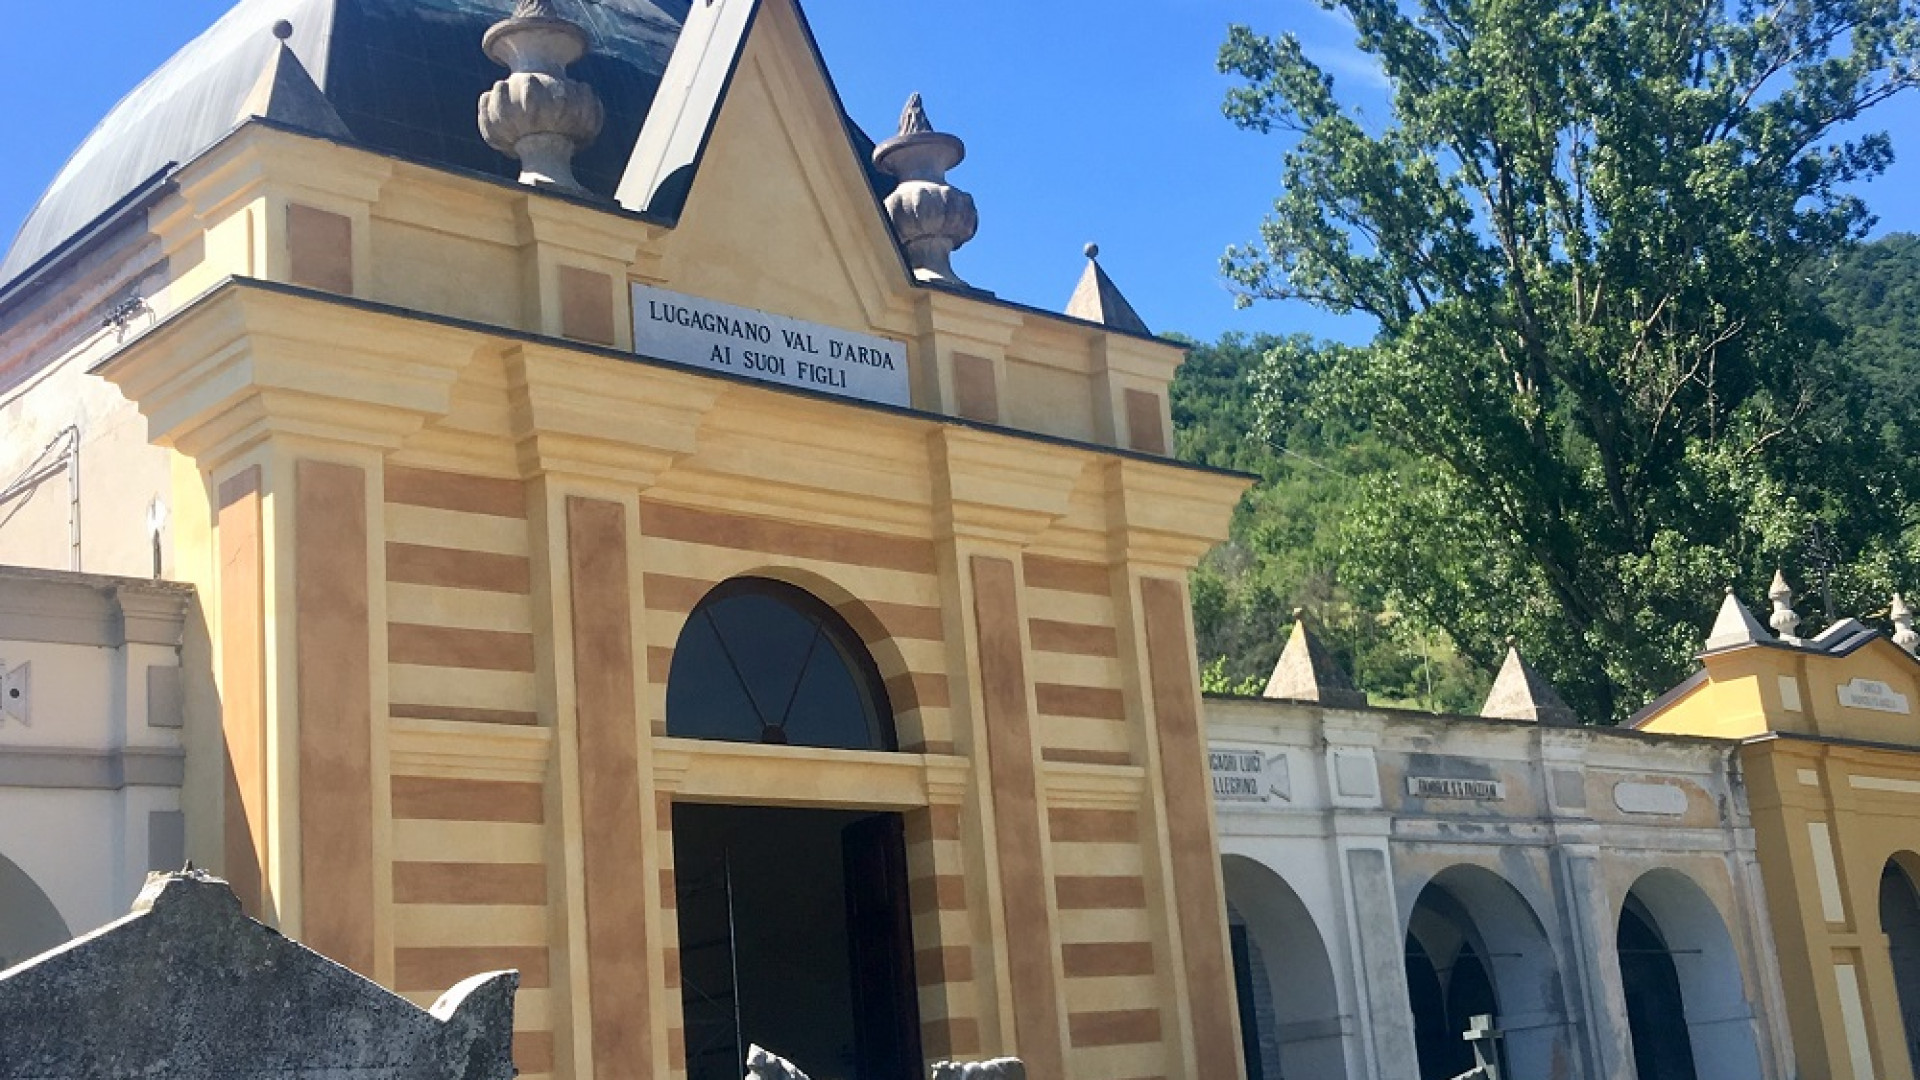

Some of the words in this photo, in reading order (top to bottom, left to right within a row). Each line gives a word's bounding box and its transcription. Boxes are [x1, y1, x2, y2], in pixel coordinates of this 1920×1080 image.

[649, 300, 771, 343] LUGAGNANO
[782, 329, 819, 353] VAL
[829, 339, 895, 370] D'ARDA
[710, 344, 732, 365] AI
[743, 351, 786, 376] SUOI
[797, 361, 846, 388] FIGLI
